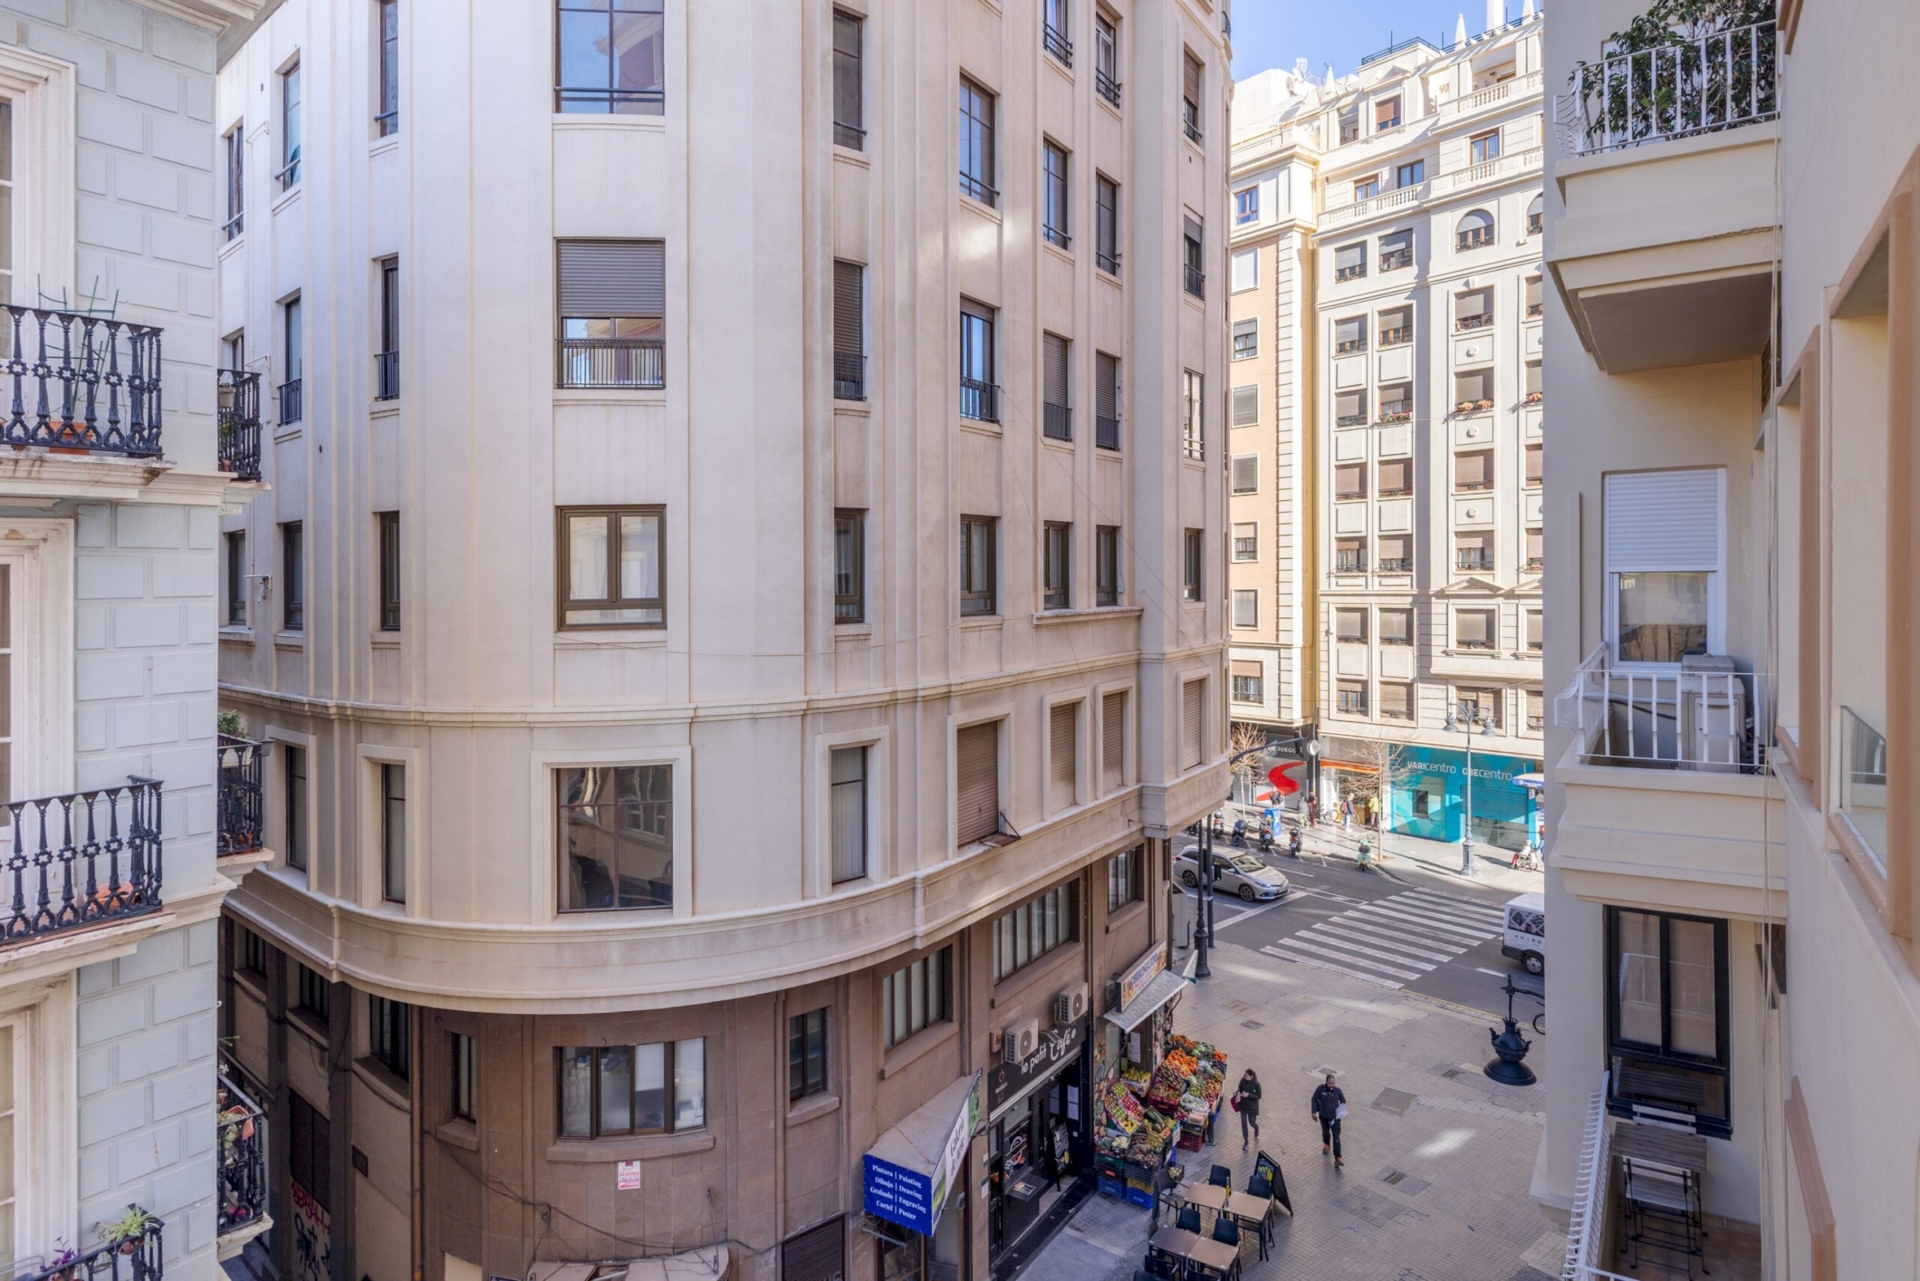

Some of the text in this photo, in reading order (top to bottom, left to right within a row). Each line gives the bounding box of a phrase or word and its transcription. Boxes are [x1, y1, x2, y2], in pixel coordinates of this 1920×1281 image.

[1407, 760, 1457, 775] VARIcentro
[1020, 1057, 1029, 1075] le
[1029, 1041, 1047, 1075] petit
[872, 1164, 922, 1189] Pintura Painting
[874, 1176, 923, 1201] Dibujo Drawing
[869, 1185, 927, 1214] Grabado Engraving
[875, 1199, 917, 1221] Cartel Poster
